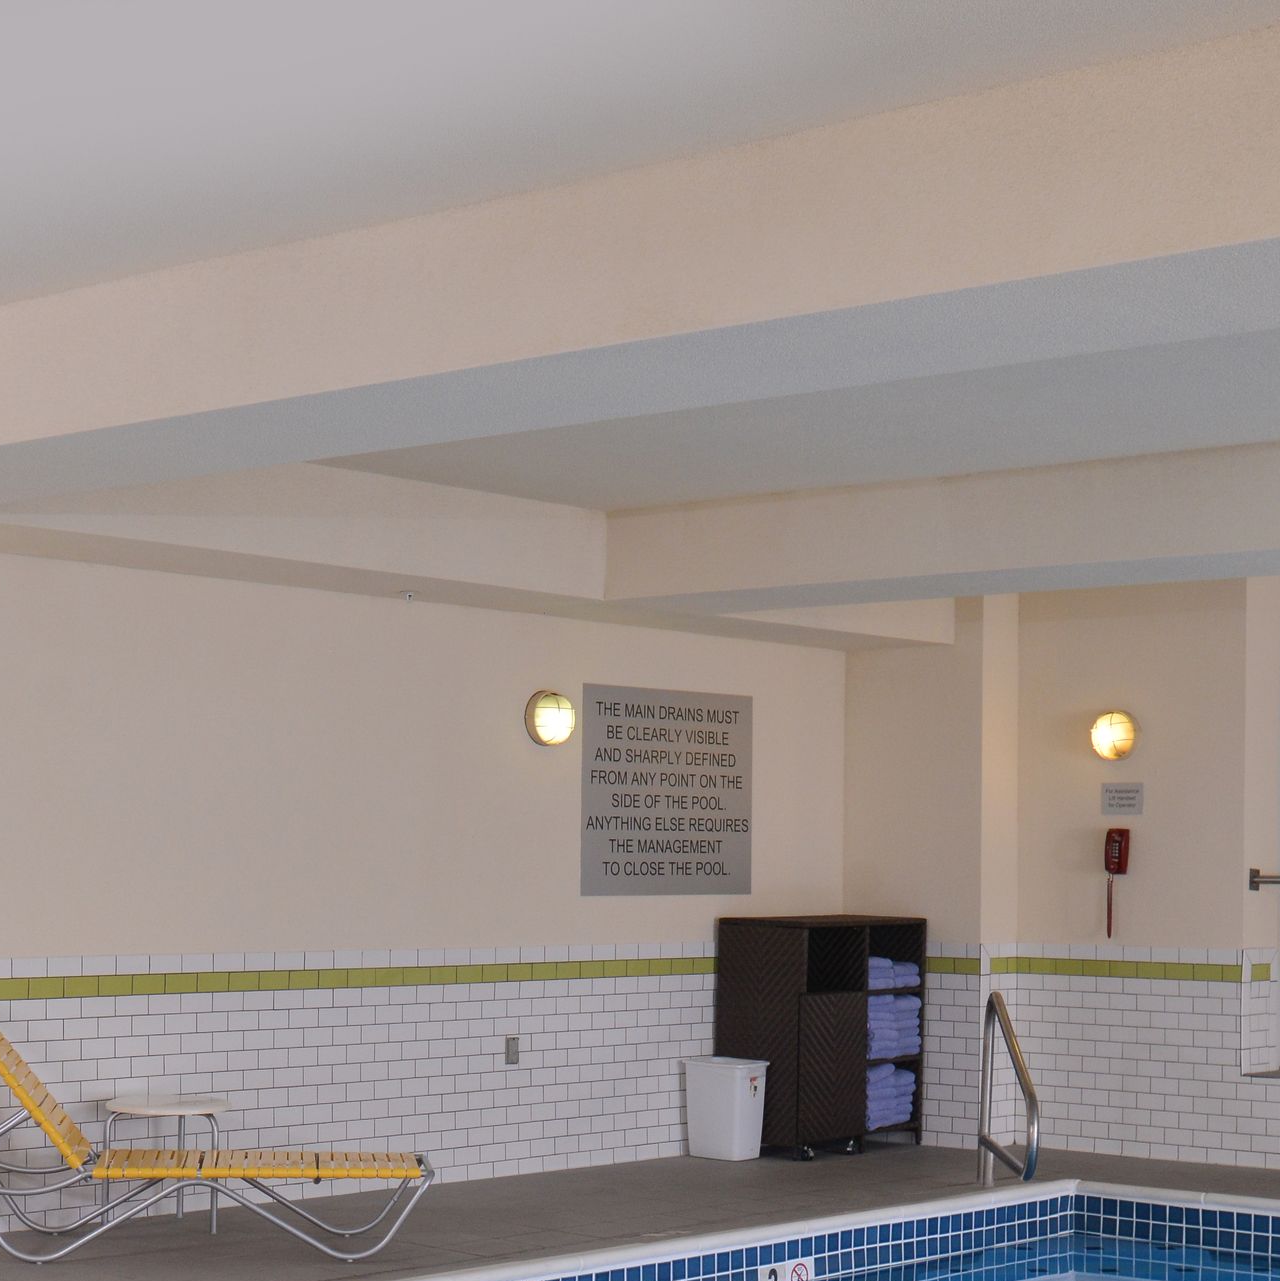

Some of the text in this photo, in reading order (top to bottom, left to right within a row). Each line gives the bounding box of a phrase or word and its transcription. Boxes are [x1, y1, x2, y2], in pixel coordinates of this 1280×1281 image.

[596, 701, 739, 724] THE MAIN DRAINS MUST
[607, 725, 729, 745] BE CLEARLY VISIBLE
[595, 748, 736, 767] AND SHARPLY DEFINED
[591, 770, 743, 790] FROM ANY POINT ON THE
[611, 794, 726, 811] SIDE OF THE POOL.
[586, 816, 749, 833] ANYTHING ELSE REQUIRES
[609, 839, 723, 854] THE MANAGEMENT
[602, 861, 731, 876] TO CLOSE THE POOL.
